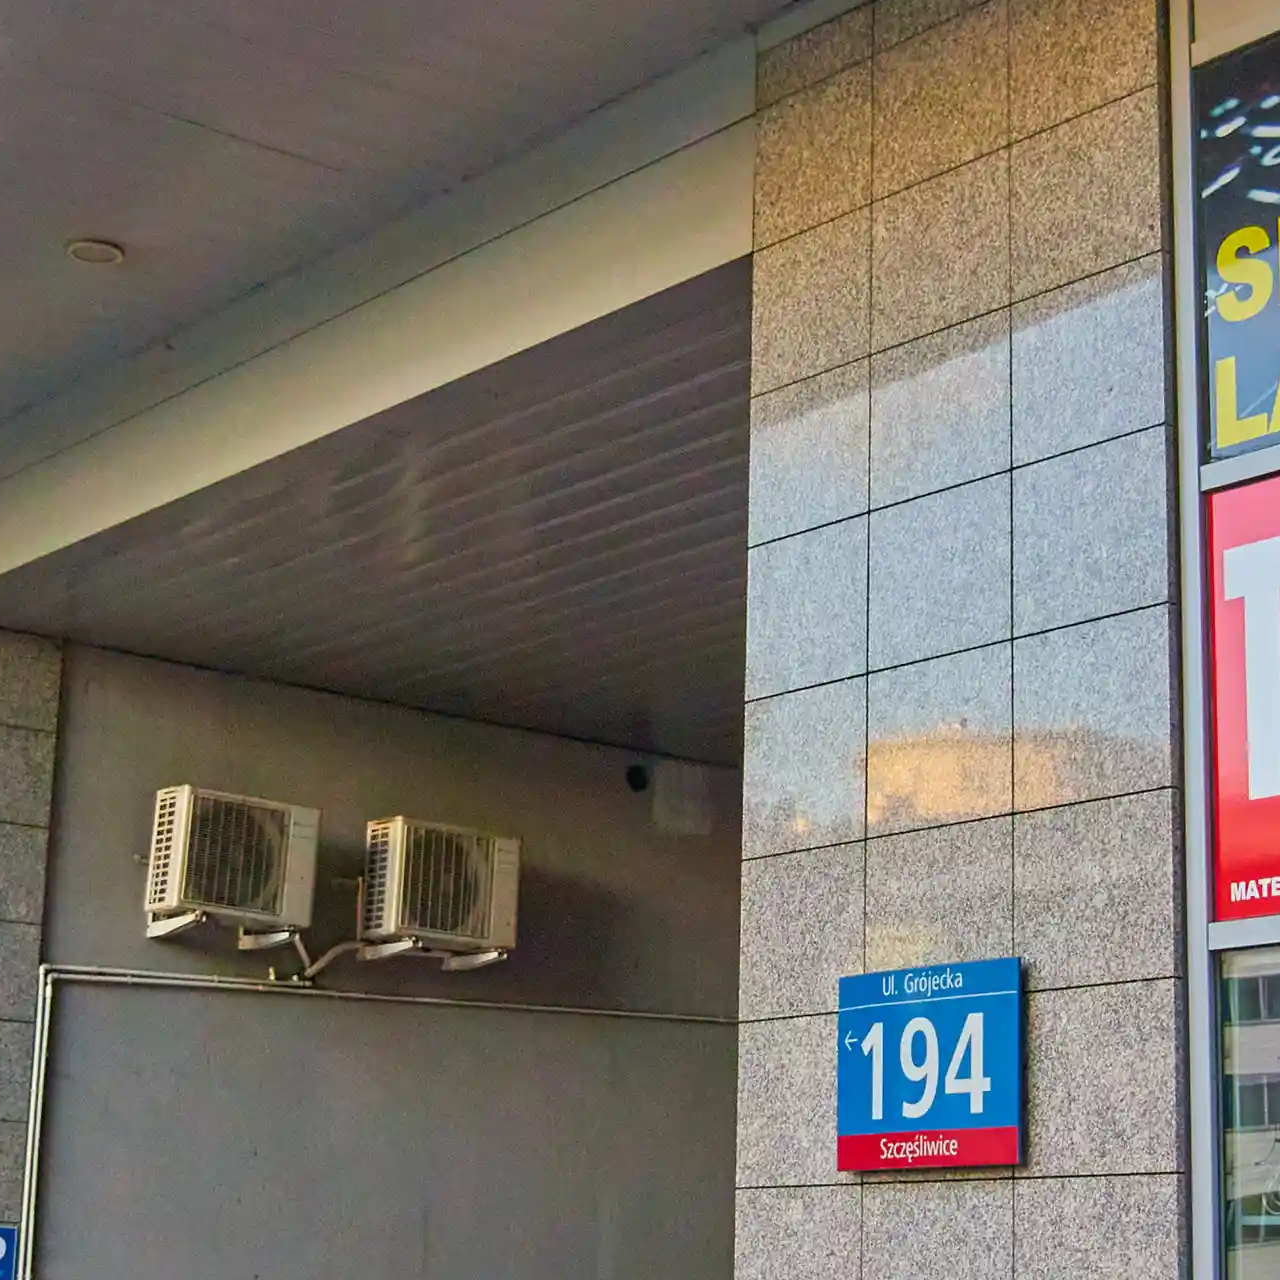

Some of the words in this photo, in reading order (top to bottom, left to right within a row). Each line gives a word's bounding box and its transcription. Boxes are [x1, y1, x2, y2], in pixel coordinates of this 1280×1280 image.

[882, 974, 898, 996] Ul.
[904, 968, 963, 997] Grójecka
[861, 1012, 992, 1120] 194
[880, 1134, 958, 1162] Szczęśliwice
